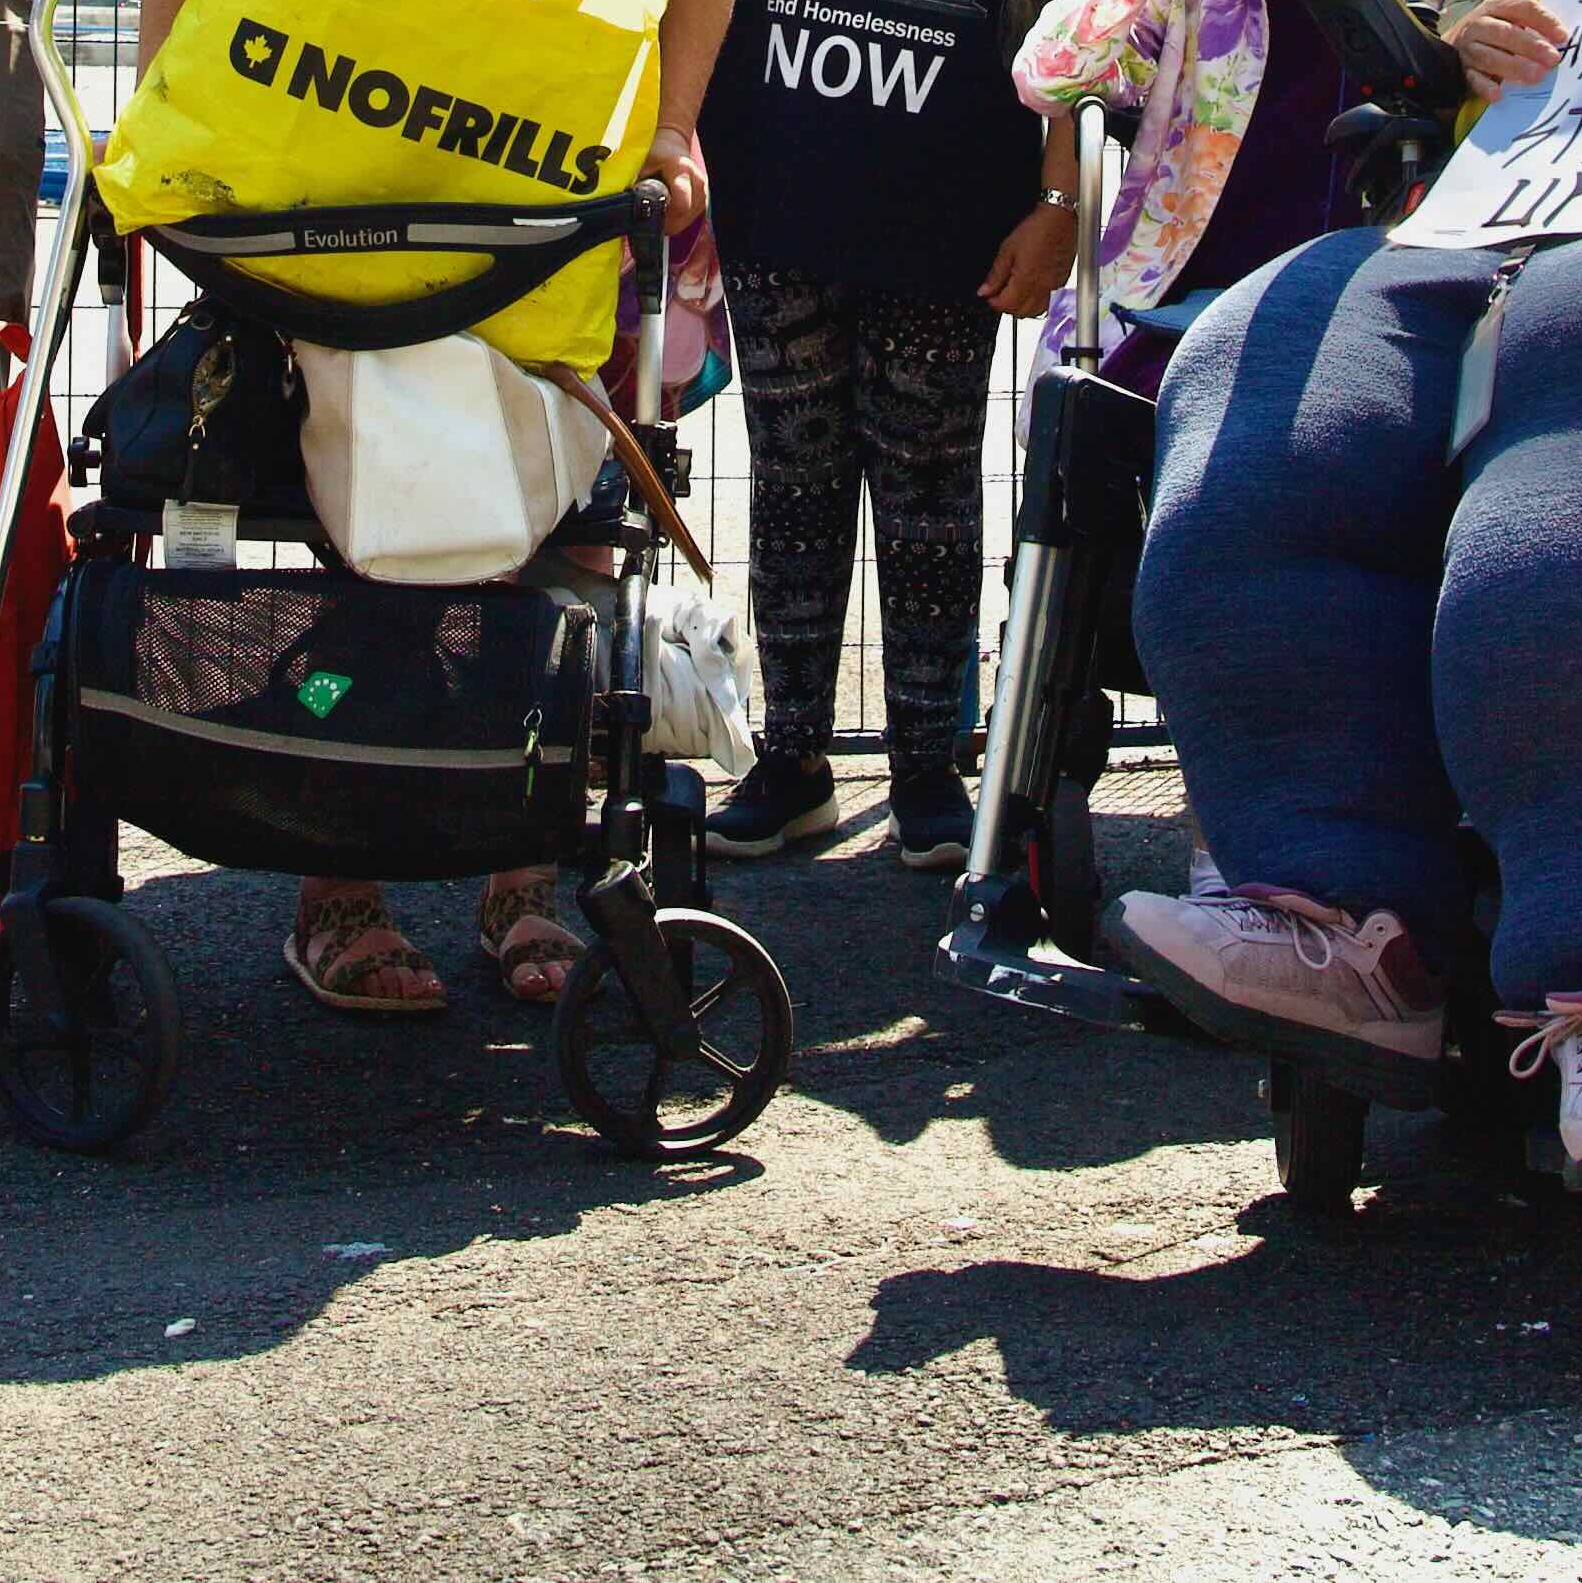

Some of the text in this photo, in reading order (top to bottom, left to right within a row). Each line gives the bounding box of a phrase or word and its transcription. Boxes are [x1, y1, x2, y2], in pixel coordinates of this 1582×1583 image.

[803, 0, 957, 49] Homelessness
[763, 23, 946, 115] NOW
[304, 225, 399, 249] Evolution
